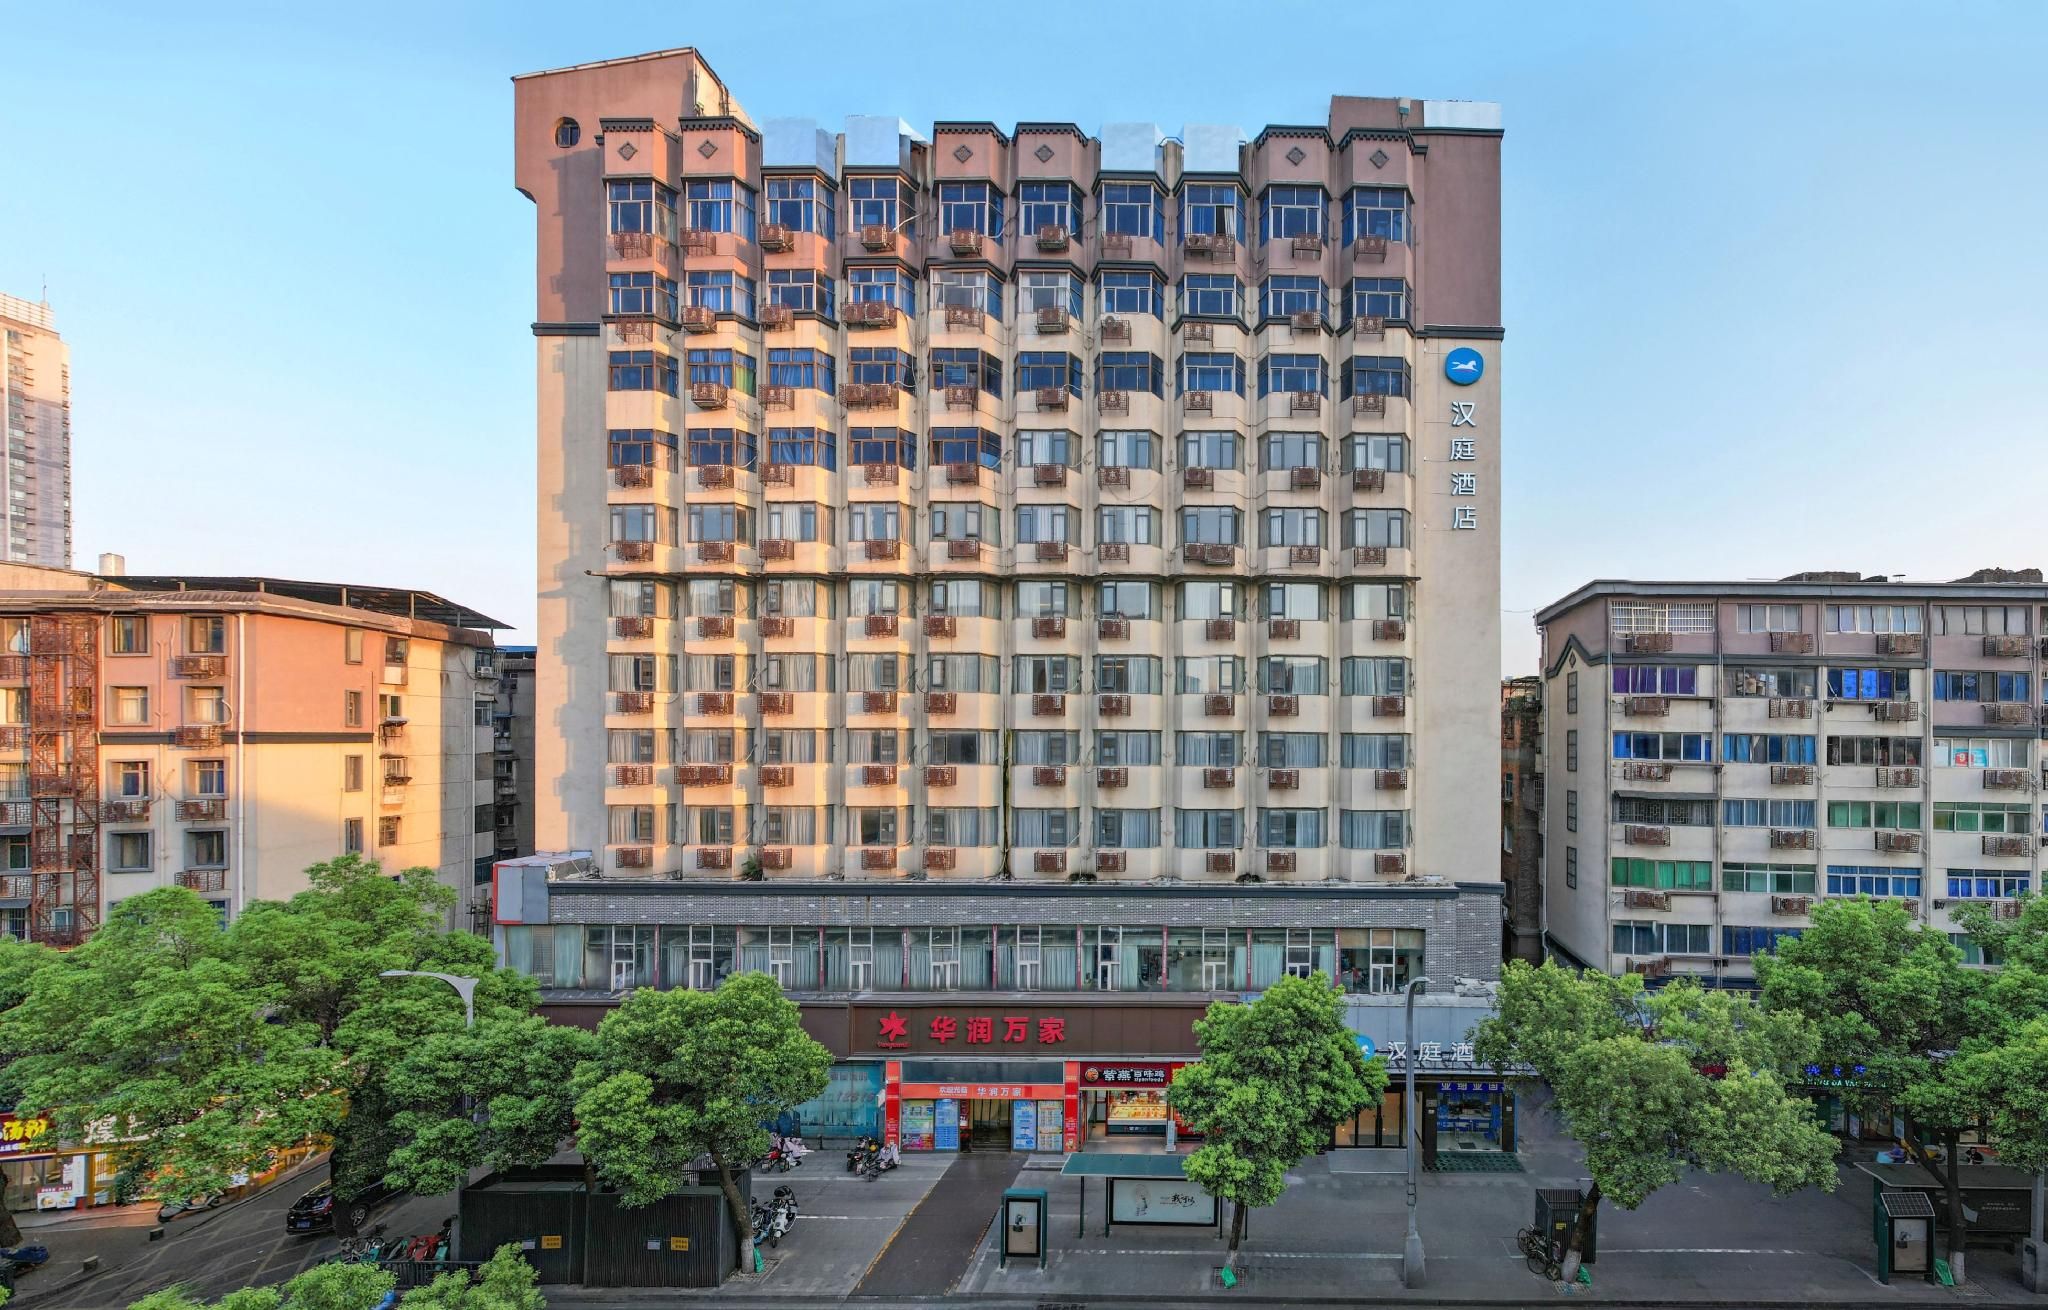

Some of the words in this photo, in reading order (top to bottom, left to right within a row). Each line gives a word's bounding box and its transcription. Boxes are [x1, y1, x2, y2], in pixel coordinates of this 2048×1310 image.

[1450, 401, 1477, 530] 汉庭酒店
[929, 1016, 1066, 1044] 华润万家
[1387, 1041, 1474, 1062] 汉庭酒
[977, 1087, 1022, 1097] 华润万家
